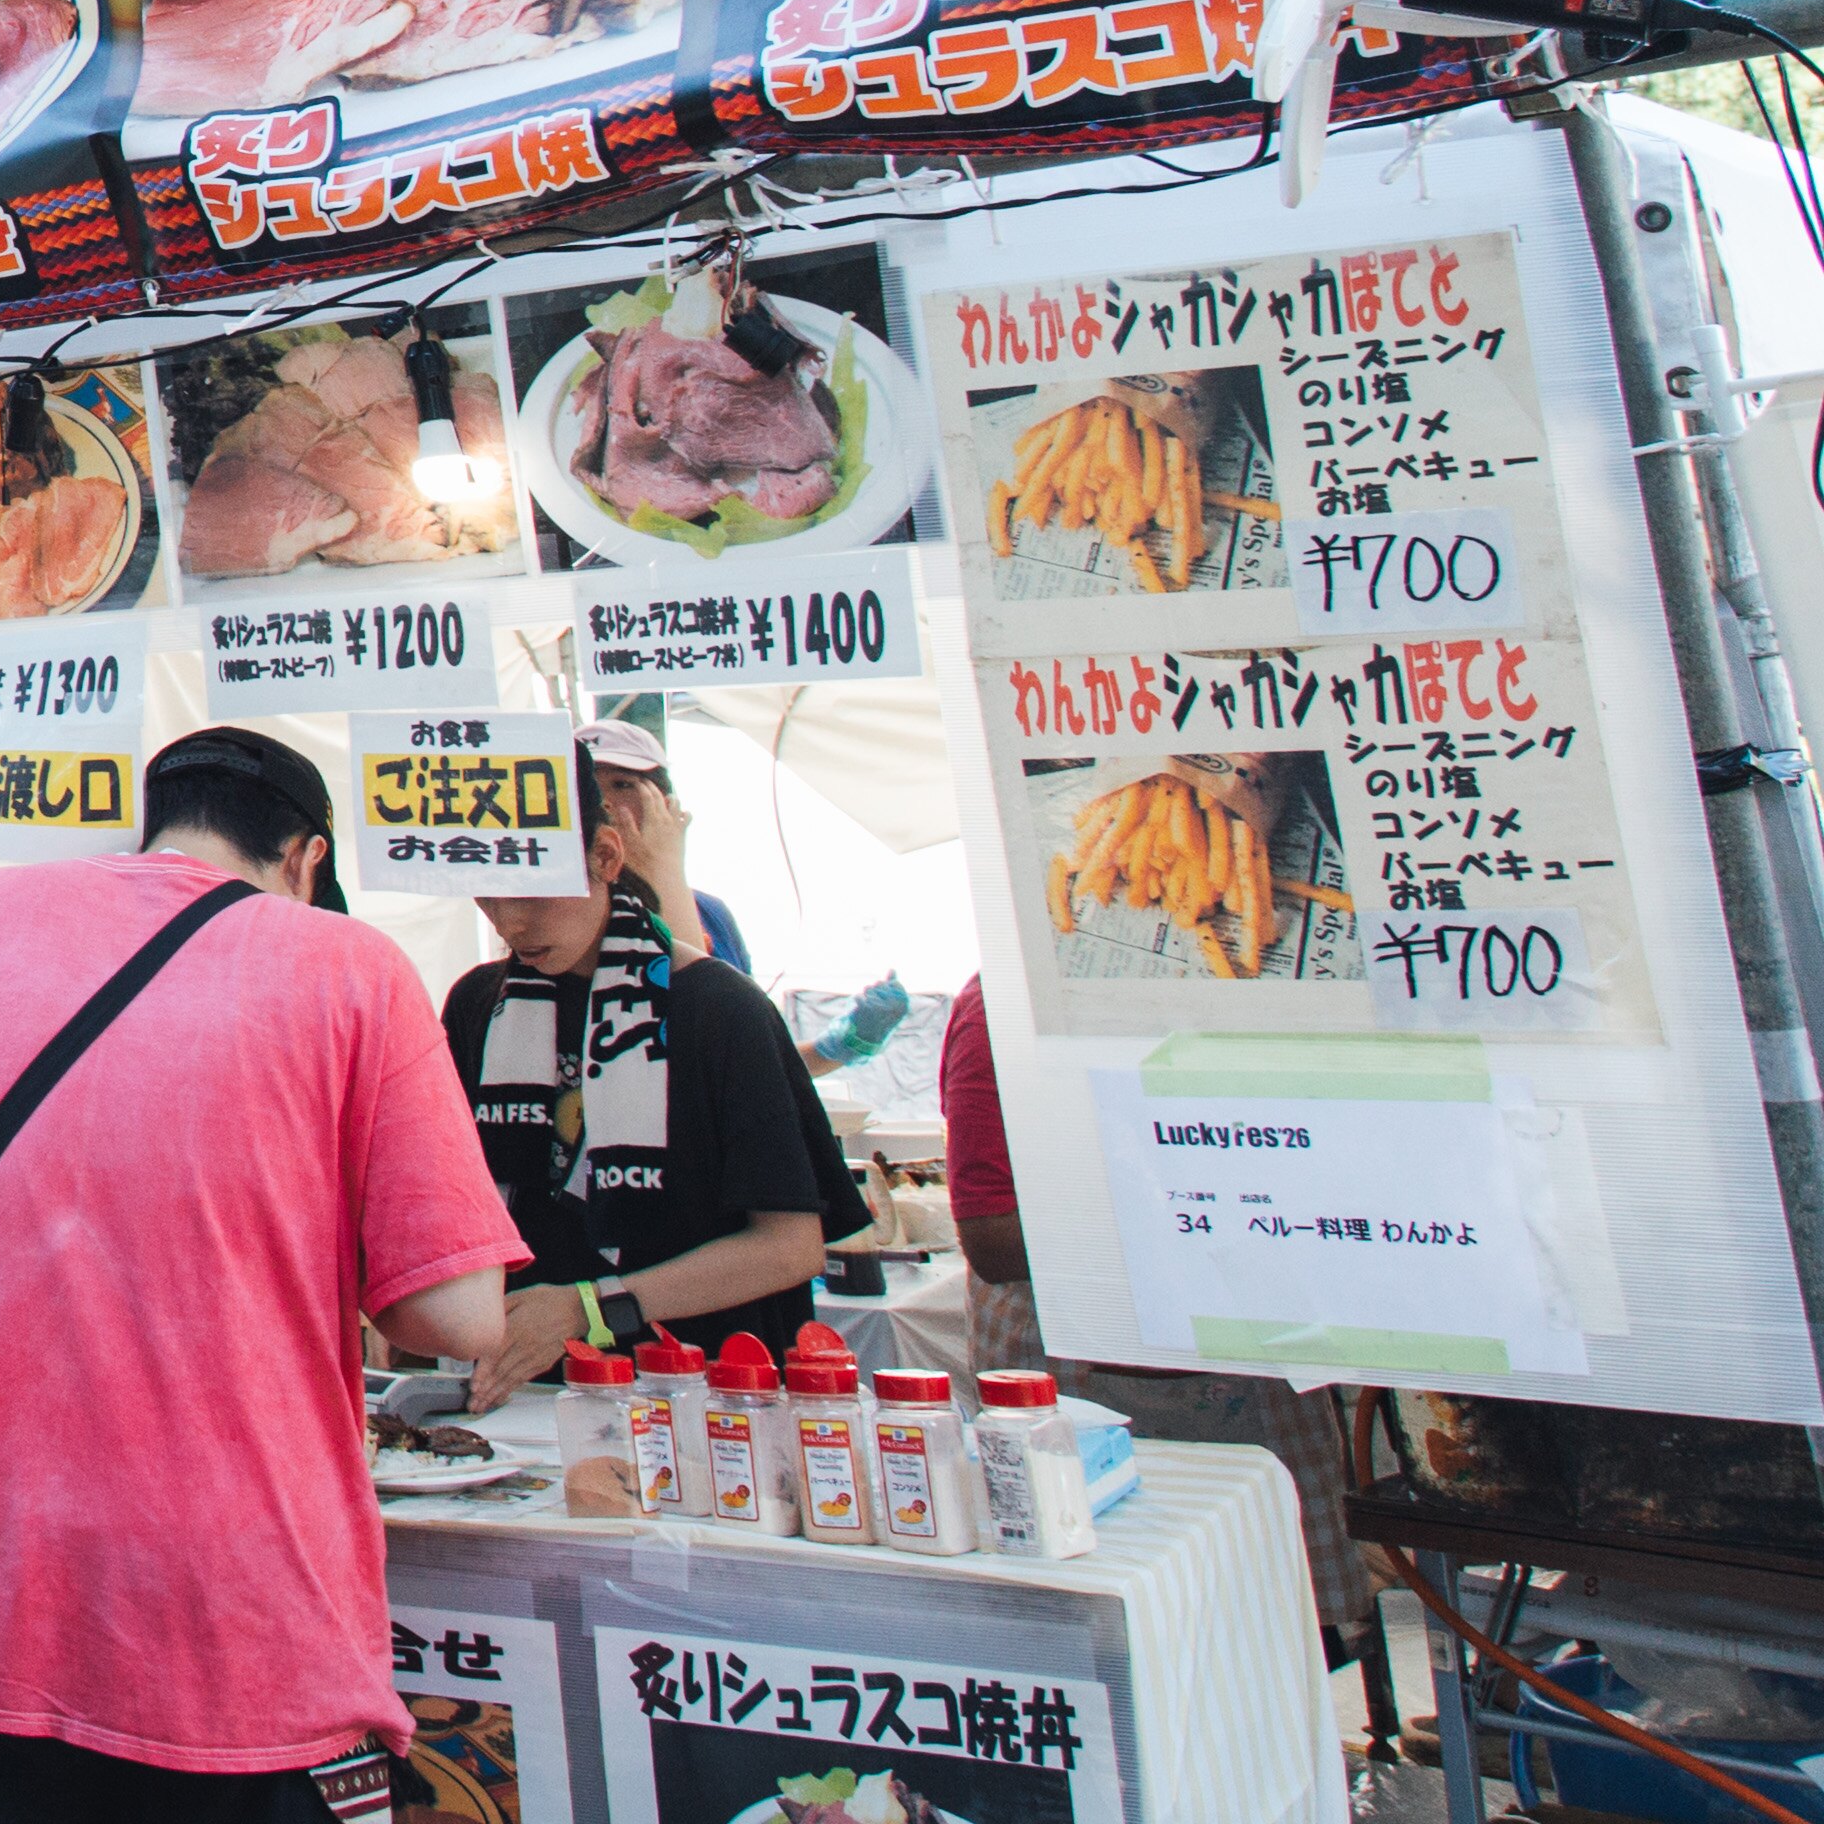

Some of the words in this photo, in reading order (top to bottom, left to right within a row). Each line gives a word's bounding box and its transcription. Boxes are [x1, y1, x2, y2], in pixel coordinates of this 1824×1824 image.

[190, 102, 338, 179] 炙り
[199, 108, 610, 250] シュラスコ焼
[956, 244, 1469, 369] わんかよシャカシャカぽてと
[1279, 327, 1506, 376] シーズニング
[1298, 372, 1411, 407] のり塩
[1303, 410, 1450, 449] コンソメ
[1309, 450, 1539, 488] バーベキュー
[1316, 482, 1391, 517] お塩
[1302, 533, 1500, 612] ¥700
[211, 609, 332, 649] 炙りシュラスコ焼
[342, 601, 464, 670] ¥1200
[588, 596, 740, 641] 炙りシュラスコ焼丼
[746, 589, 884, 666] ¥1400
[14, 655, 119, 715] ¥1300
[1009, 637, 1538, 737] わんかよシャカシャカぽてと
[410, 720, 490, 747] お食事
[1343, 726, 1576, 763] シーズニング
[373, 755, 560, 828] ご注文口
[1366, 766, 1481, 799] のり塩
[1372, 807, 1522, 840] コンソメ
[388, 835, 548, 866] お会計
[1382, 850, 1615, 881] バーベキュー
[1389, 879, 1466, 911] お塩
[1372, 922, 1563, 1000] ¥700
[507, 1103, 554, 1127] FES.
[595, 1165, 663, 1190] ROCK
[1166, 1190, 1216, 1202] ブース番号
[1175, 1213, 1213, 1234] 34
[1248, 1216, 1372, 1242] ペルー料理
[1381, 1220, 1479, 1246] わんかよ
[628, 1641, 1083, 1769] 炙りシュラスコ焼丼
